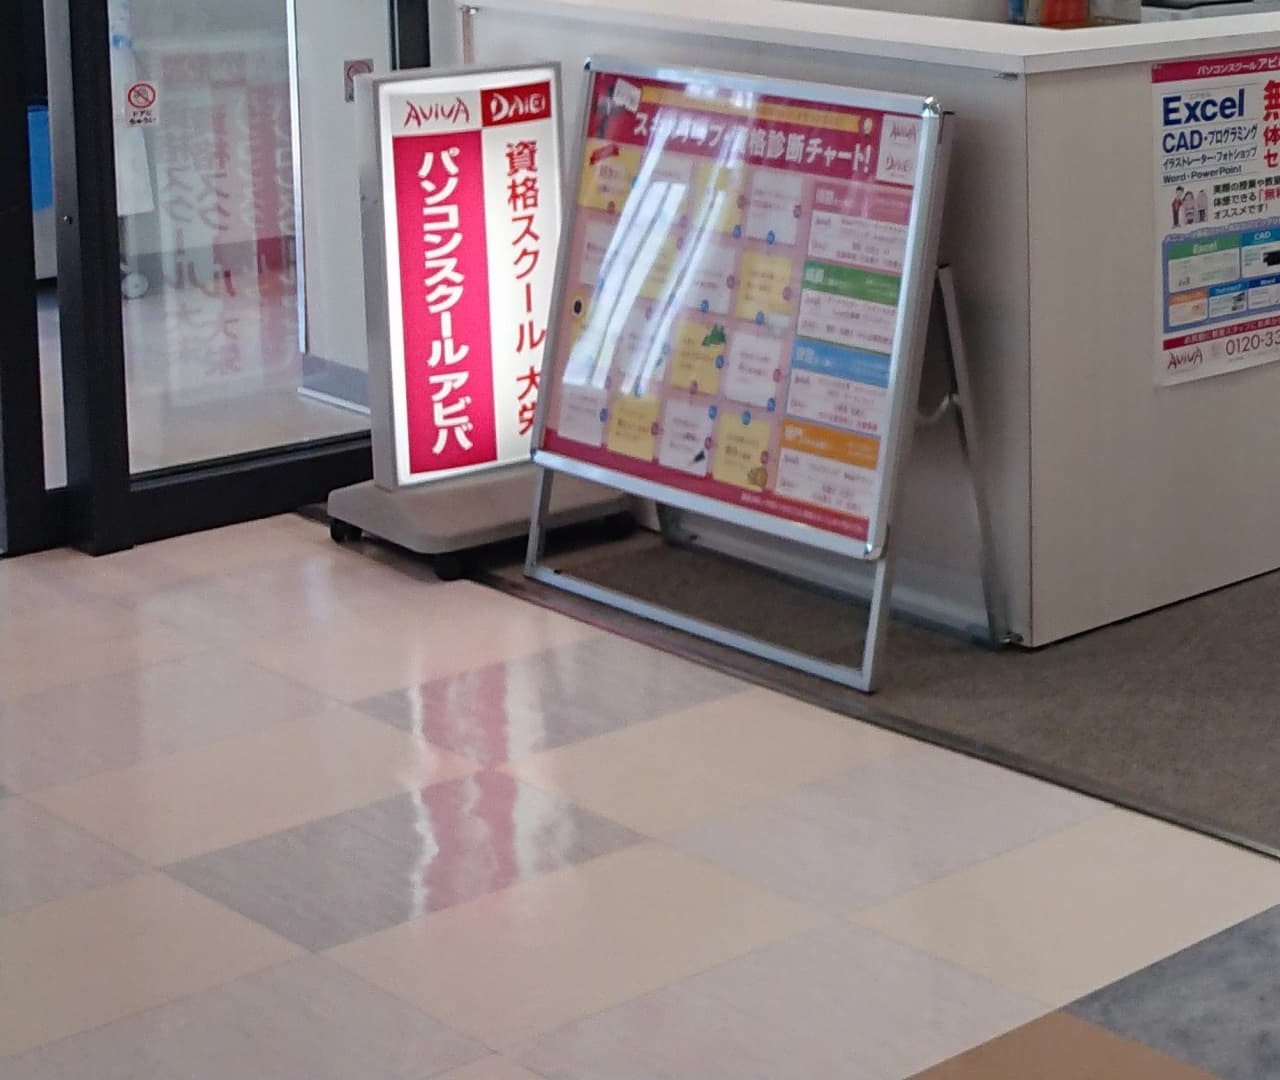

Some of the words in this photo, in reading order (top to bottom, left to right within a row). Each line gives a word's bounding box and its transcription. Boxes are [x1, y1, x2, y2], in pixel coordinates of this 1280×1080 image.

[1163, 89, 1245, 126] Excel
[1163, 124, 1258, 153] CAD・プログラミング
[1163, 147, 1257, 170] イラストレーター・フォトショップ
[417, 147, 470, 368] パソコンスクール
[505, 140, 547, 354] 資格スクール
[429, 373, 474, 454] アビバ
